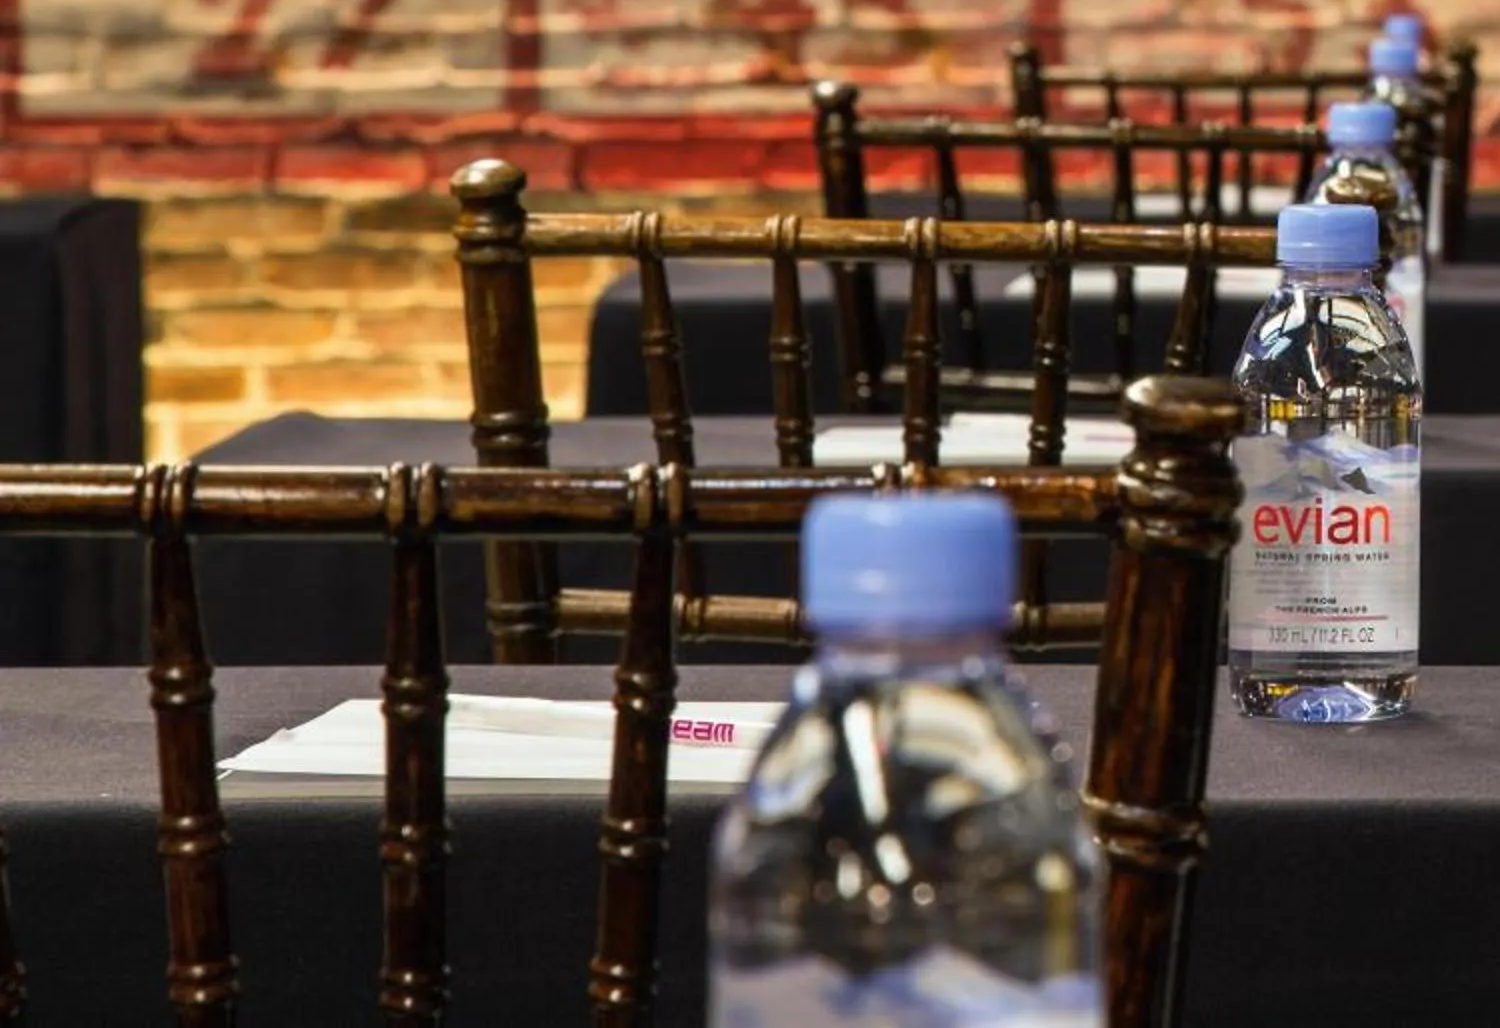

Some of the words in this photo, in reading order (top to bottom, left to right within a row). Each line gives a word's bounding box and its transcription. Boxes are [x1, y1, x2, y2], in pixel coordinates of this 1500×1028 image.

[1253, 496, 1391, 545] evian
[1306, 553, 1351, 562] SPRING
[1355, 552, 1390, 562] WATER
[1305, 596, 1337, 605] FROM
[669, 719, 735, 743] eam
